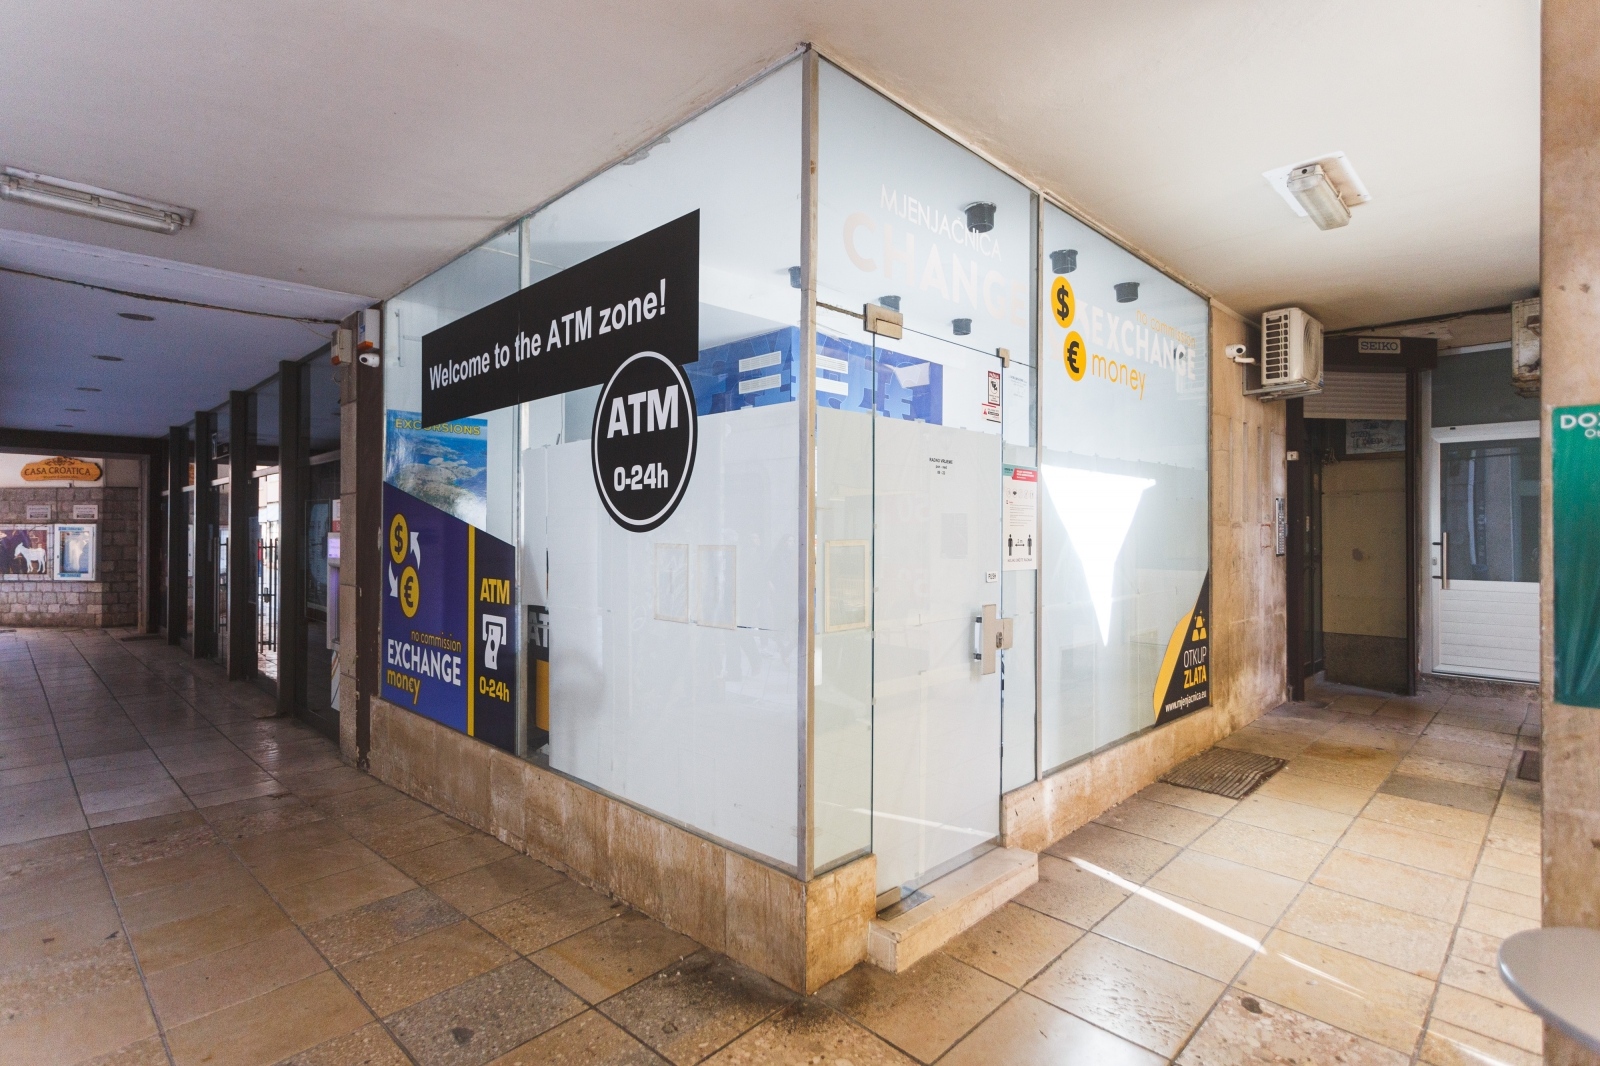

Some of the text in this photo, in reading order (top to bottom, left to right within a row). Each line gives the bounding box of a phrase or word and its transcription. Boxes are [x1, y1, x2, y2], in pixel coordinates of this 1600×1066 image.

[880, 184, 1002, 262] MJENJAČNICA
[843, 211, 1028, 328] CHANGE
[429, 278, 667, 391] Welcome to the ATM zone!
[1136, 309, 1196, 348] no commission
[1091, 305, 1196, 381] EXCHANGE
[1360, 341, 1399, 351] SEIKO
[1091, 353, 1147, 401] money
[606, 384, 680, 439] ATM
[1559, 412, 1600, 429] DO
[395, 418, 481, 436] EXCRSIONS
[24, 466, 91, 476] CASA CROATICA
[613, 462, 669, 493] 0-24h
[479, 577, 510, 605] ATM
[411, 630, 462, 653] no commission
[387, 638, 462, 687] EXCHANGE
[1183, 645, 1207, 668] OTKUP
[479, 678, 510, 703] 0-24h
[1183, 664, 1207, 689] ZLATA
[1165, 690, 1207, 713] www.mjenjacnica.eu
